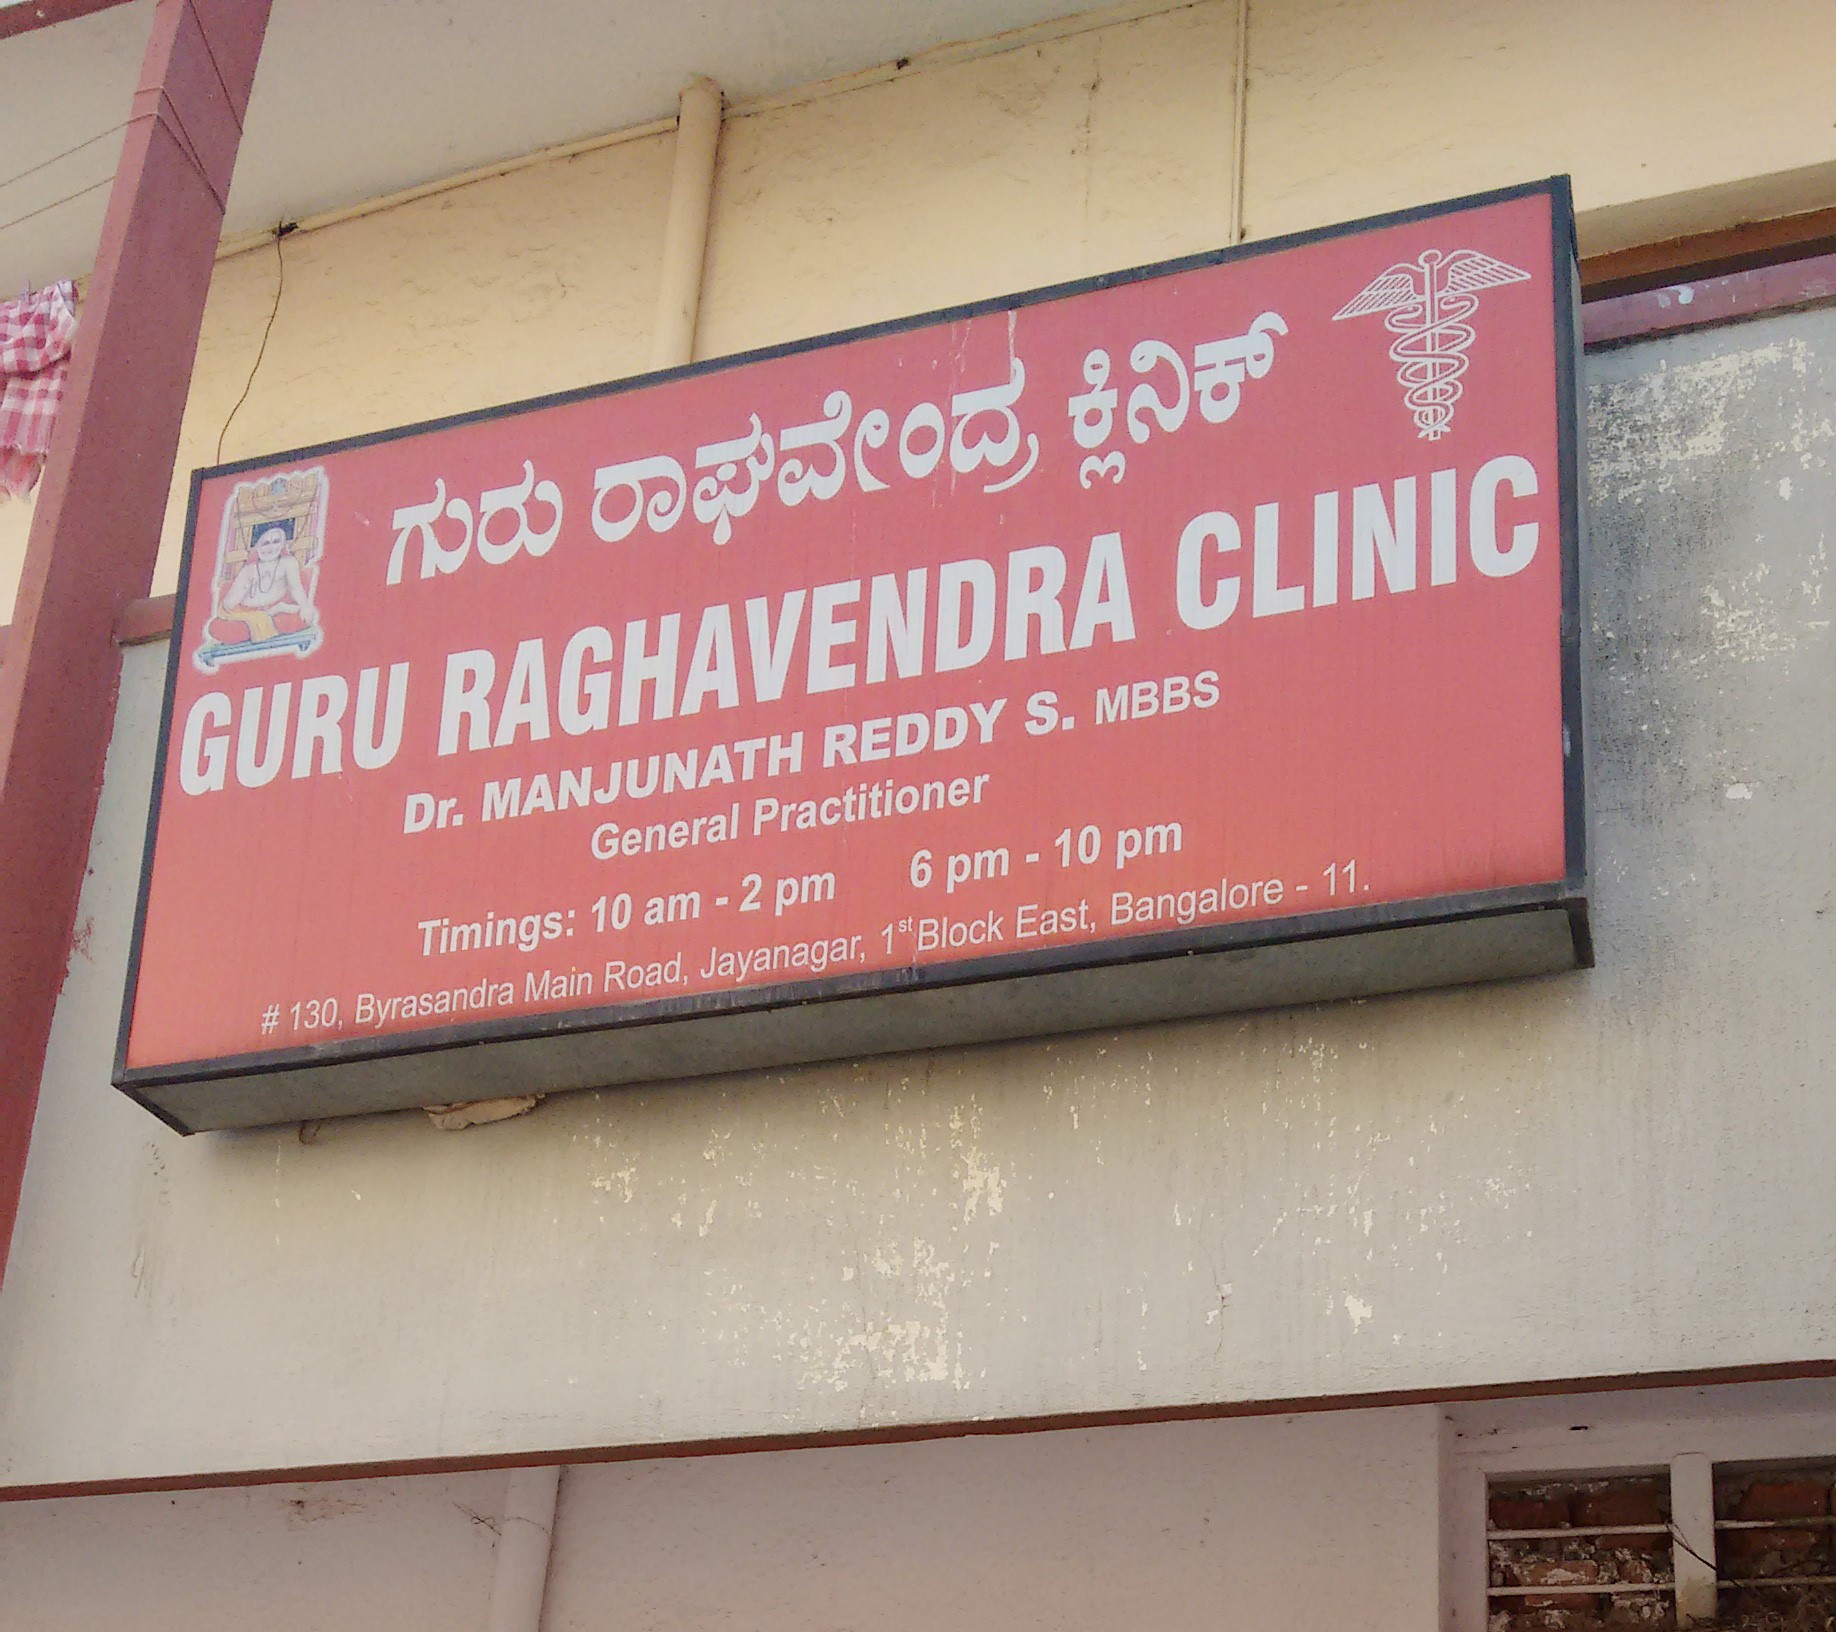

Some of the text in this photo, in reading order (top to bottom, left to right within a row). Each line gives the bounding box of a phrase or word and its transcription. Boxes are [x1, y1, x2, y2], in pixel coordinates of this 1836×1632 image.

[386, 312, 1288, 586] ಗುರು ರಾಘವೇಂದ್ರ ಕ್ಲಿನಿಕ್
[180, 456, 1539, 796] GURU RAGHAVENDRA CLINIC
[404, 670, 1219, 834] Dr. MANJUNATH REDDY S. MBBS
[592, 774, 989, 860] General Practitioner
[418, 872, 835, 956] Timings: 10 am - 2 pm
[911, 823, 1182, 893] 6 pm - 10 pm
[262, 1005, 280, 1034] #
[291, 998, 342, 1030] 130,
[356, 979, 514, 1028] Byrasandra
[525, 967, 592, 1002] Main
[604, 953, 688, 992] Road,
[701, 936, 865, 981] Jayanagar,
[882, 917, 912, 954] 1st
[917, 911, 1003, 951] Block
[1017, 900, 1095, 938] East,
[1111, 880, 1283, 925] Bangalore
[1325, 860, 1368, 895] 11.
